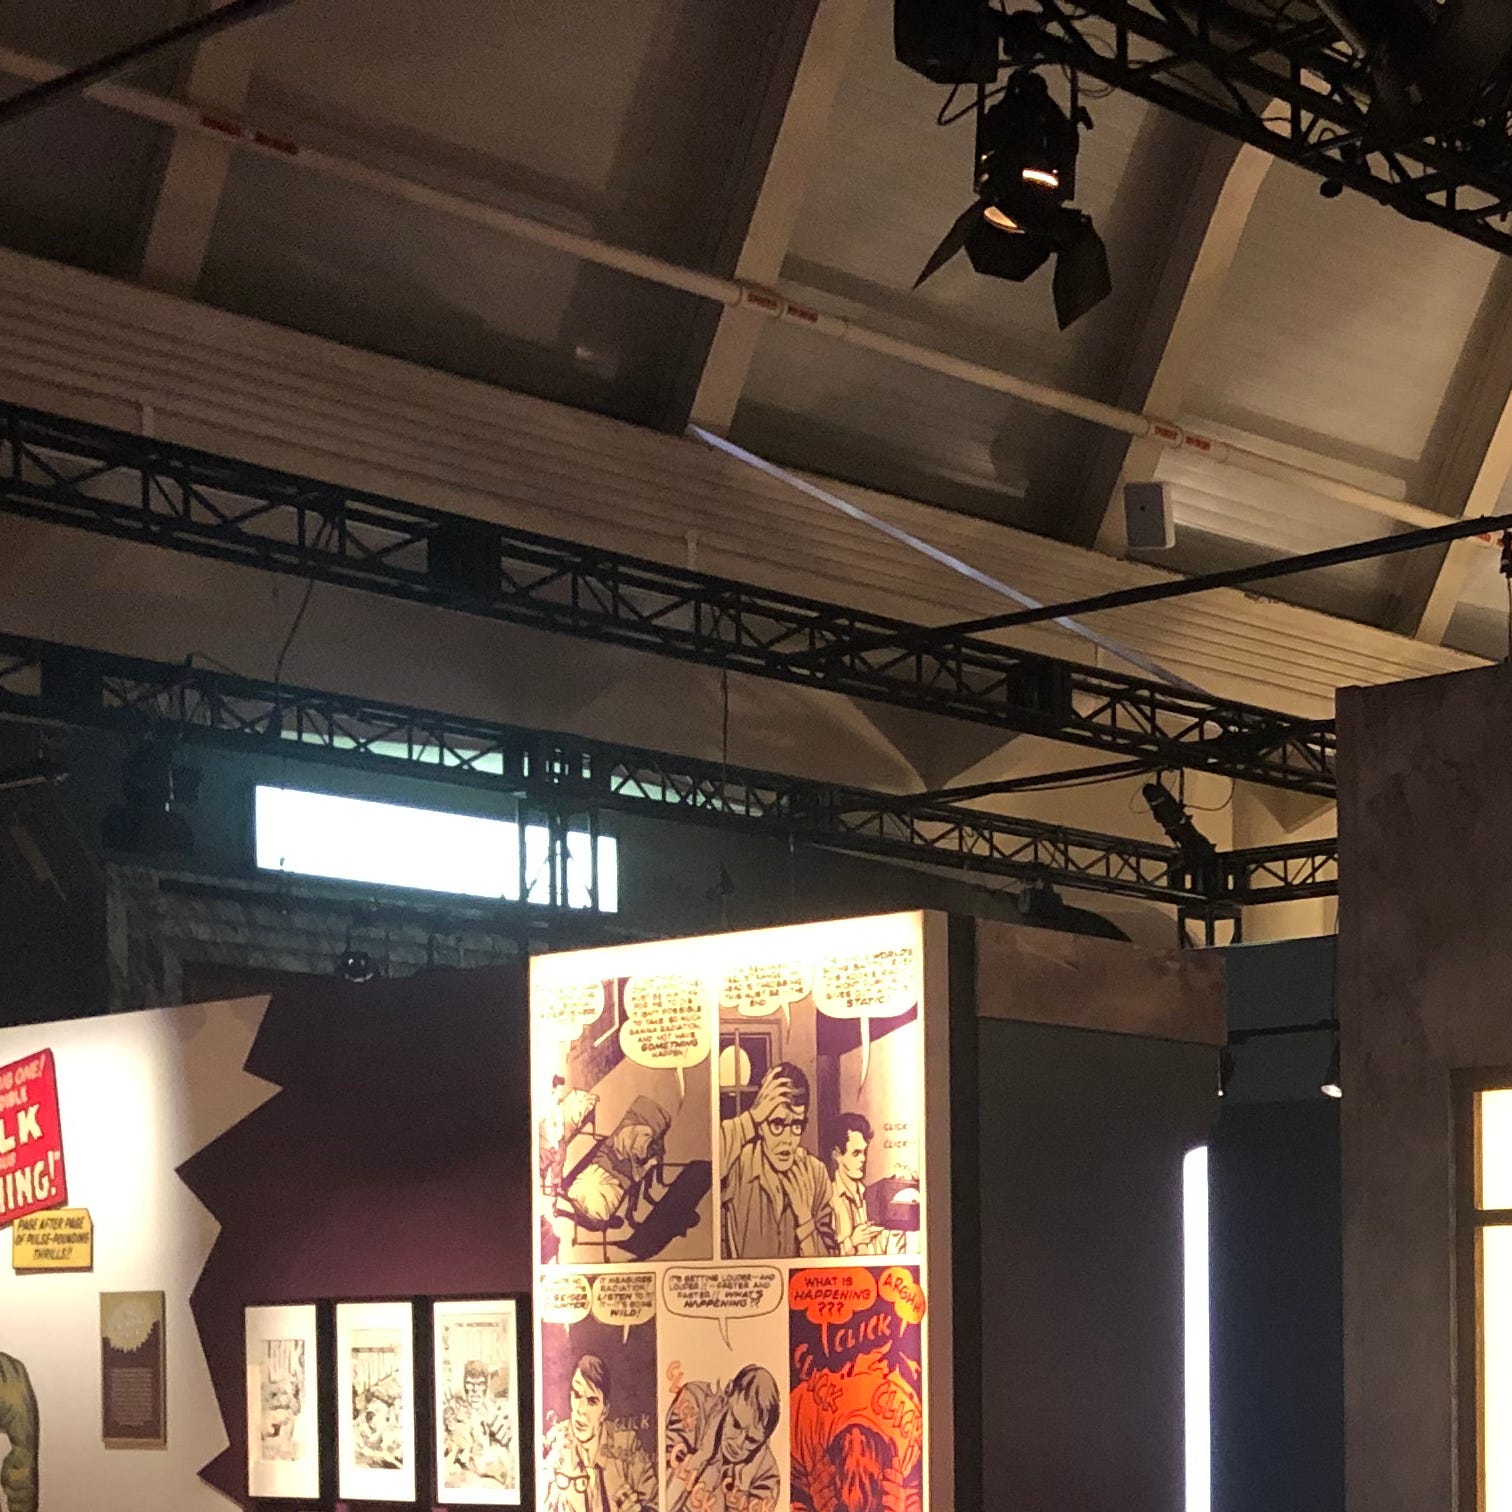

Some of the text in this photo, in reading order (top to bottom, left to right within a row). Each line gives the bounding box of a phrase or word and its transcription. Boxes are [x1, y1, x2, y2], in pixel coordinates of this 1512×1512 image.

[14, 1053, 47, 1085] ONE!
[0, 1103, 43, 1154] LK
[18, 1216, 84, 1231] PAGE AFTER PAGE
[15, 1233, 26, 1246] OF
[608, 1275, 653, 1285] MEASURES
[804, 1276, 853, 1288] WHAT IS
[597, 1293, 633, 1302] LISTEN
[725, 1289, 764, 1299] WHAT'S
[794, 1289, 872, 1302] HAPPENING
[610, 1308, 642, 1318] WILD!
[818, 1302, 845, 1317] ???
[834, 1313, 892, 1353] CLICK
